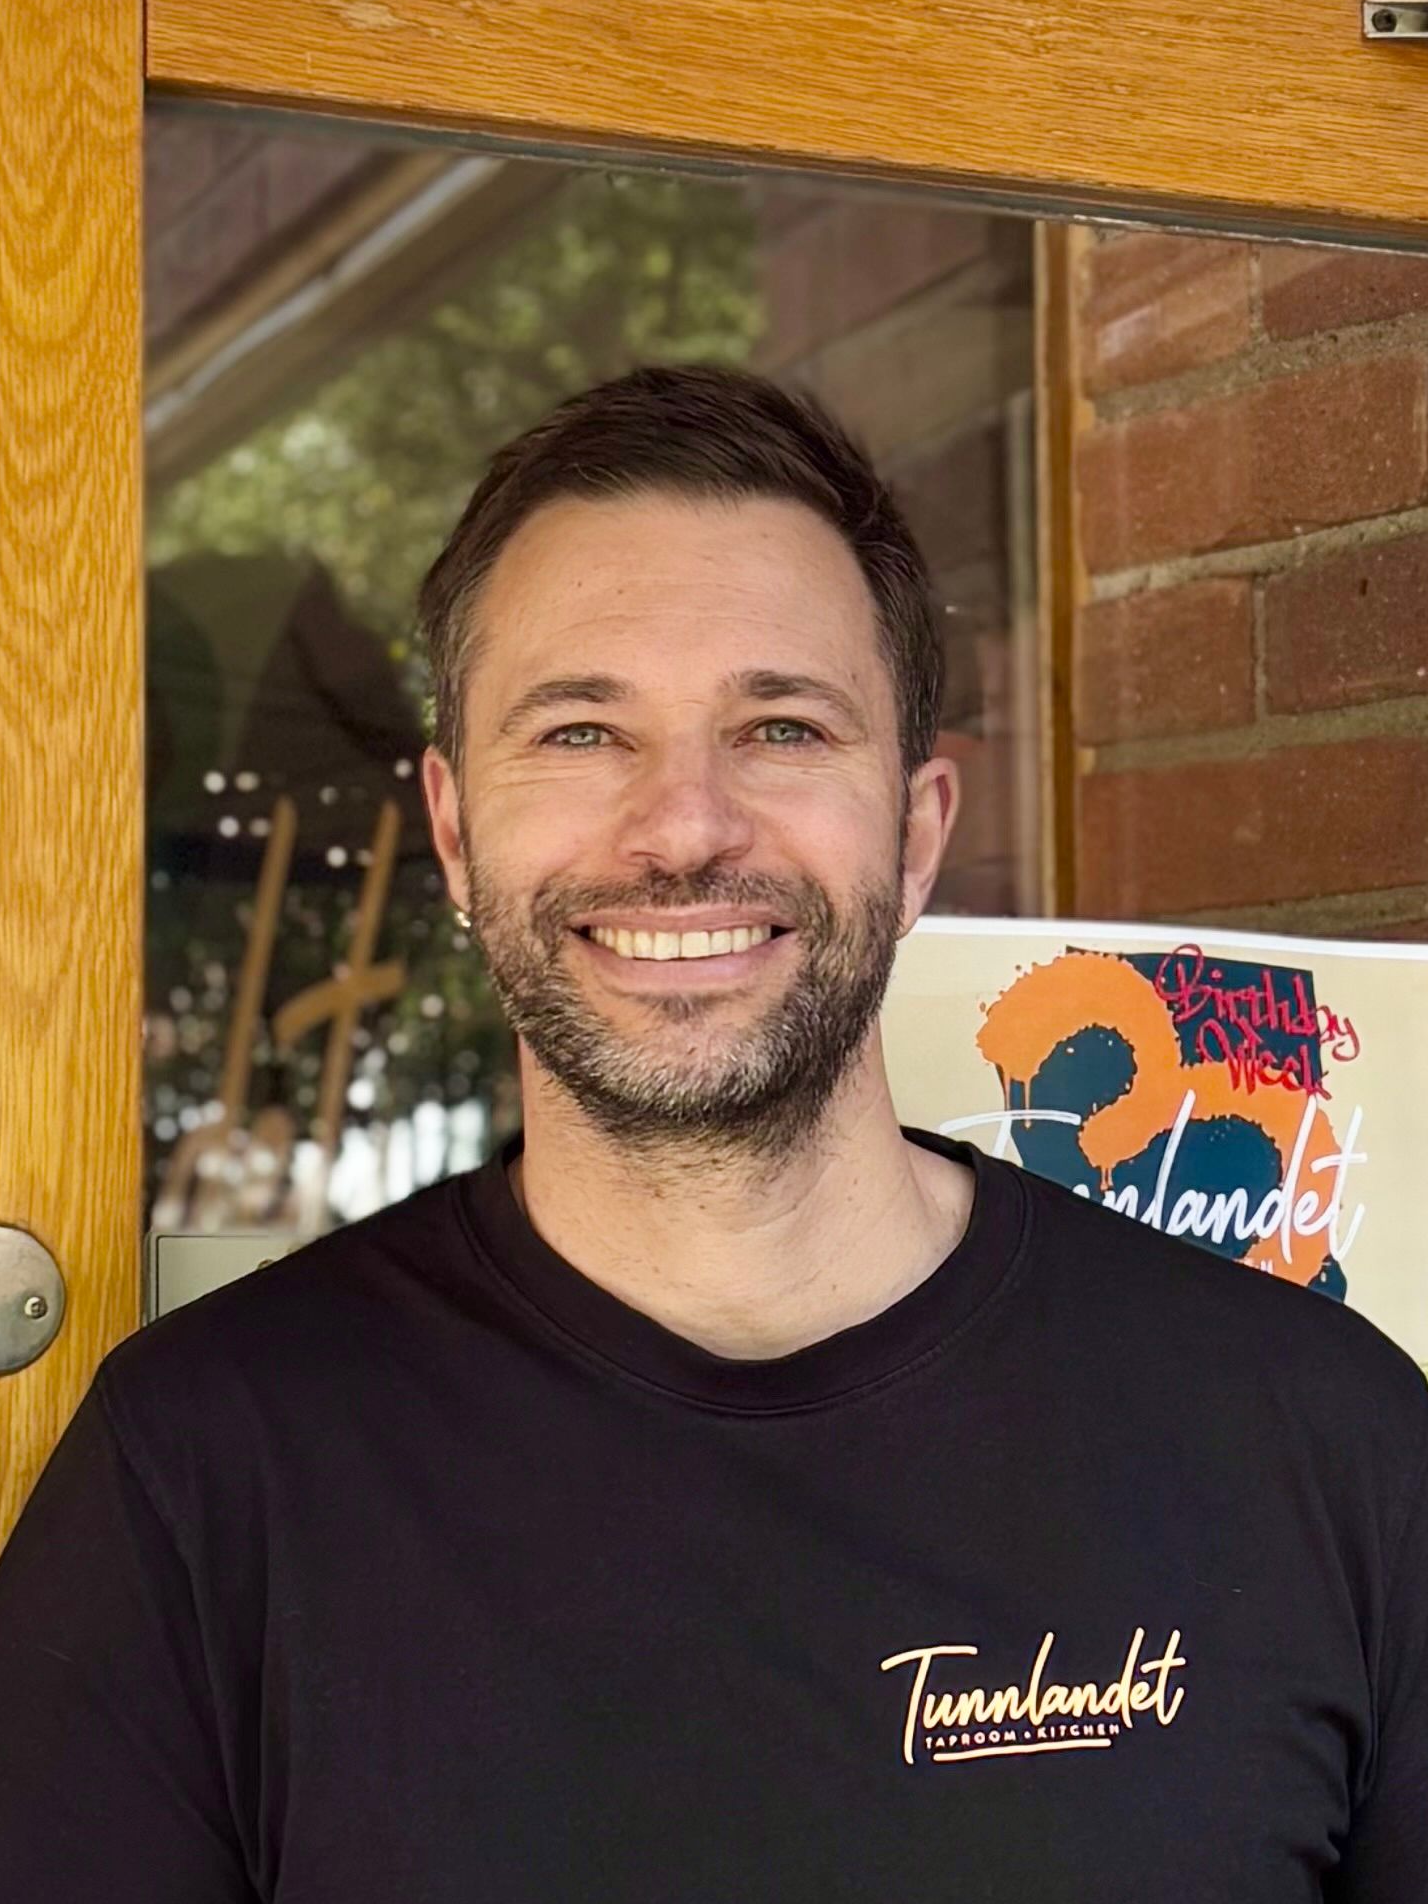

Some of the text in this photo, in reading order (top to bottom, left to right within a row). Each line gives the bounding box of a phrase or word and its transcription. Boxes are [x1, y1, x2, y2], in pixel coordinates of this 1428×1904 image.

[1153, 943, 1361, 1062] Birthday
[1196, 1018, 1333, 1101] Week
[938, 1088, 1369, 1265] Tnlandet
[880, 1626, 1187, 1765] Tunnlandet
[925, 1723, 1121, 1749] TAPROOM KITCHEN
